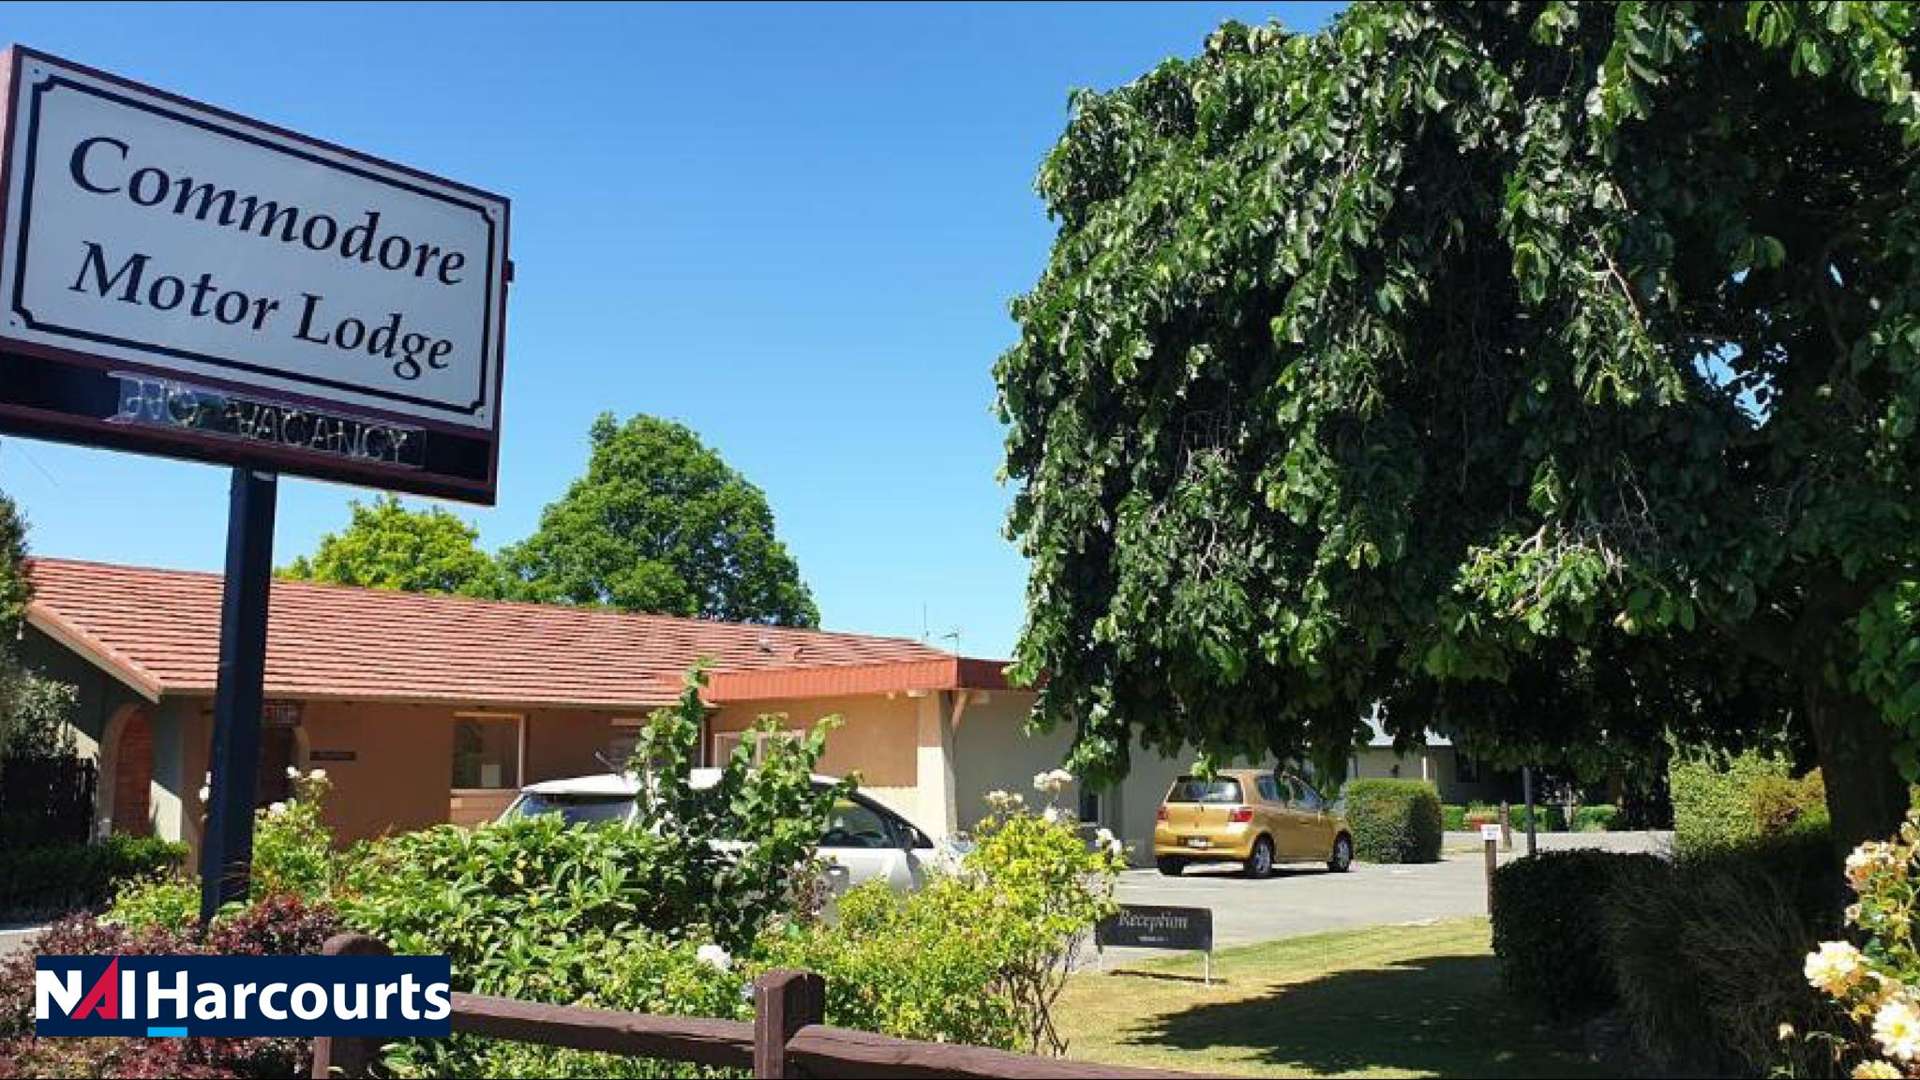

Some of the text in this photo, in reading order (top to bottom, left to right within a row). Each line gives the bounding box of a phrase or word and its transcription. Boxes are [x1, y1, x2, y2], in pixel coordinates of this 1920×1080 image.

[68, 136, 466, 286] Commodore
[67, 240, 454, 381] Motor Lodge
[223, 397, 408, 465] VACANCY
[1118, 908, 1189, 933] Reception
